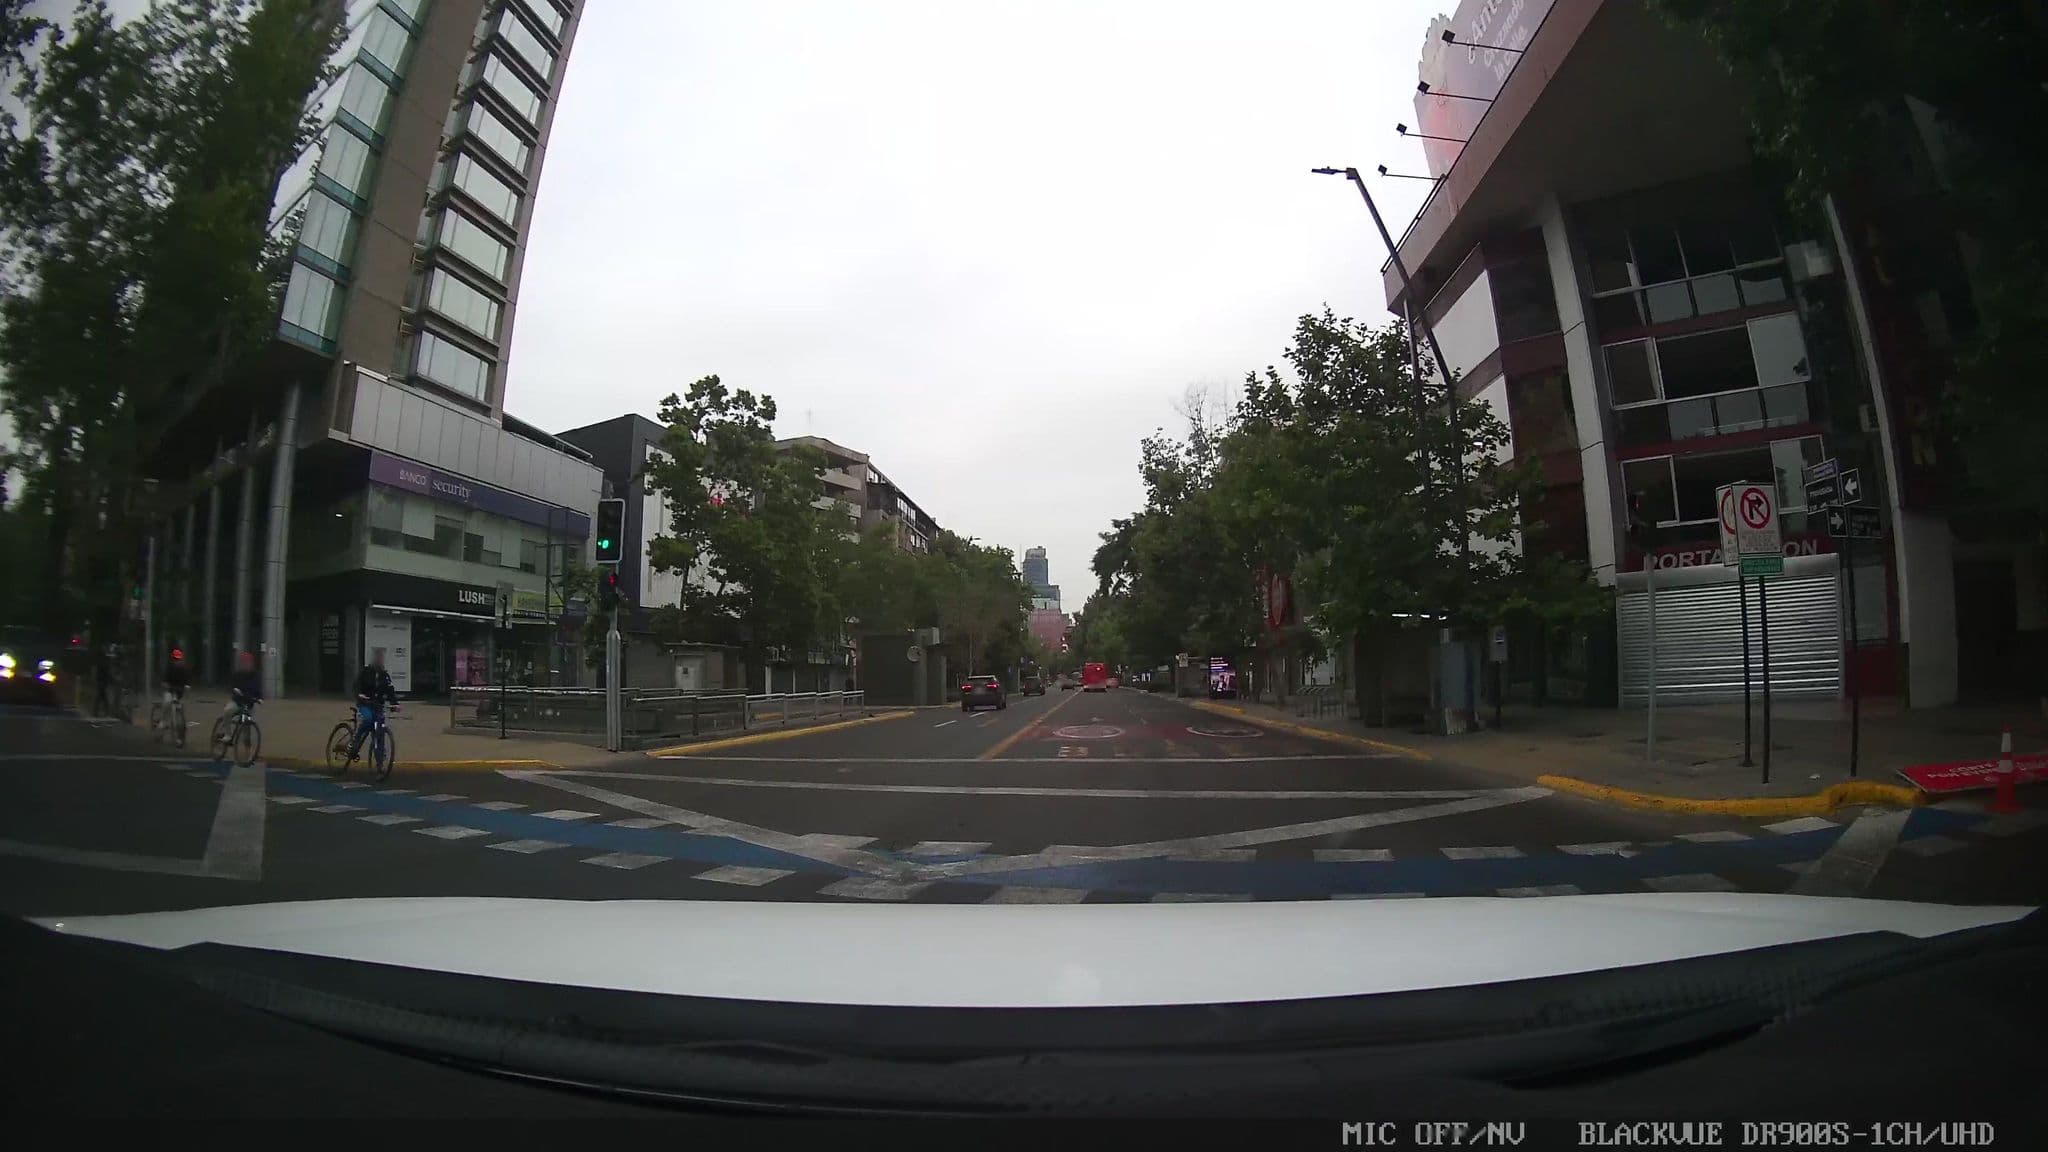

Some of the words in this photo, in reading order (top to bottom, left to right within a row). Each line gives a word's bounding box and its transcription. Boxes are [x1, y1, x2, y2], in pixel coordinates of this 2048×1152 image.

[400, 469, 427, 486] BANCO
[431, 479, 471, 503] security
[1643, 548, 1724, 573] PORTA
[458, 590, 485, 605] LUSH
